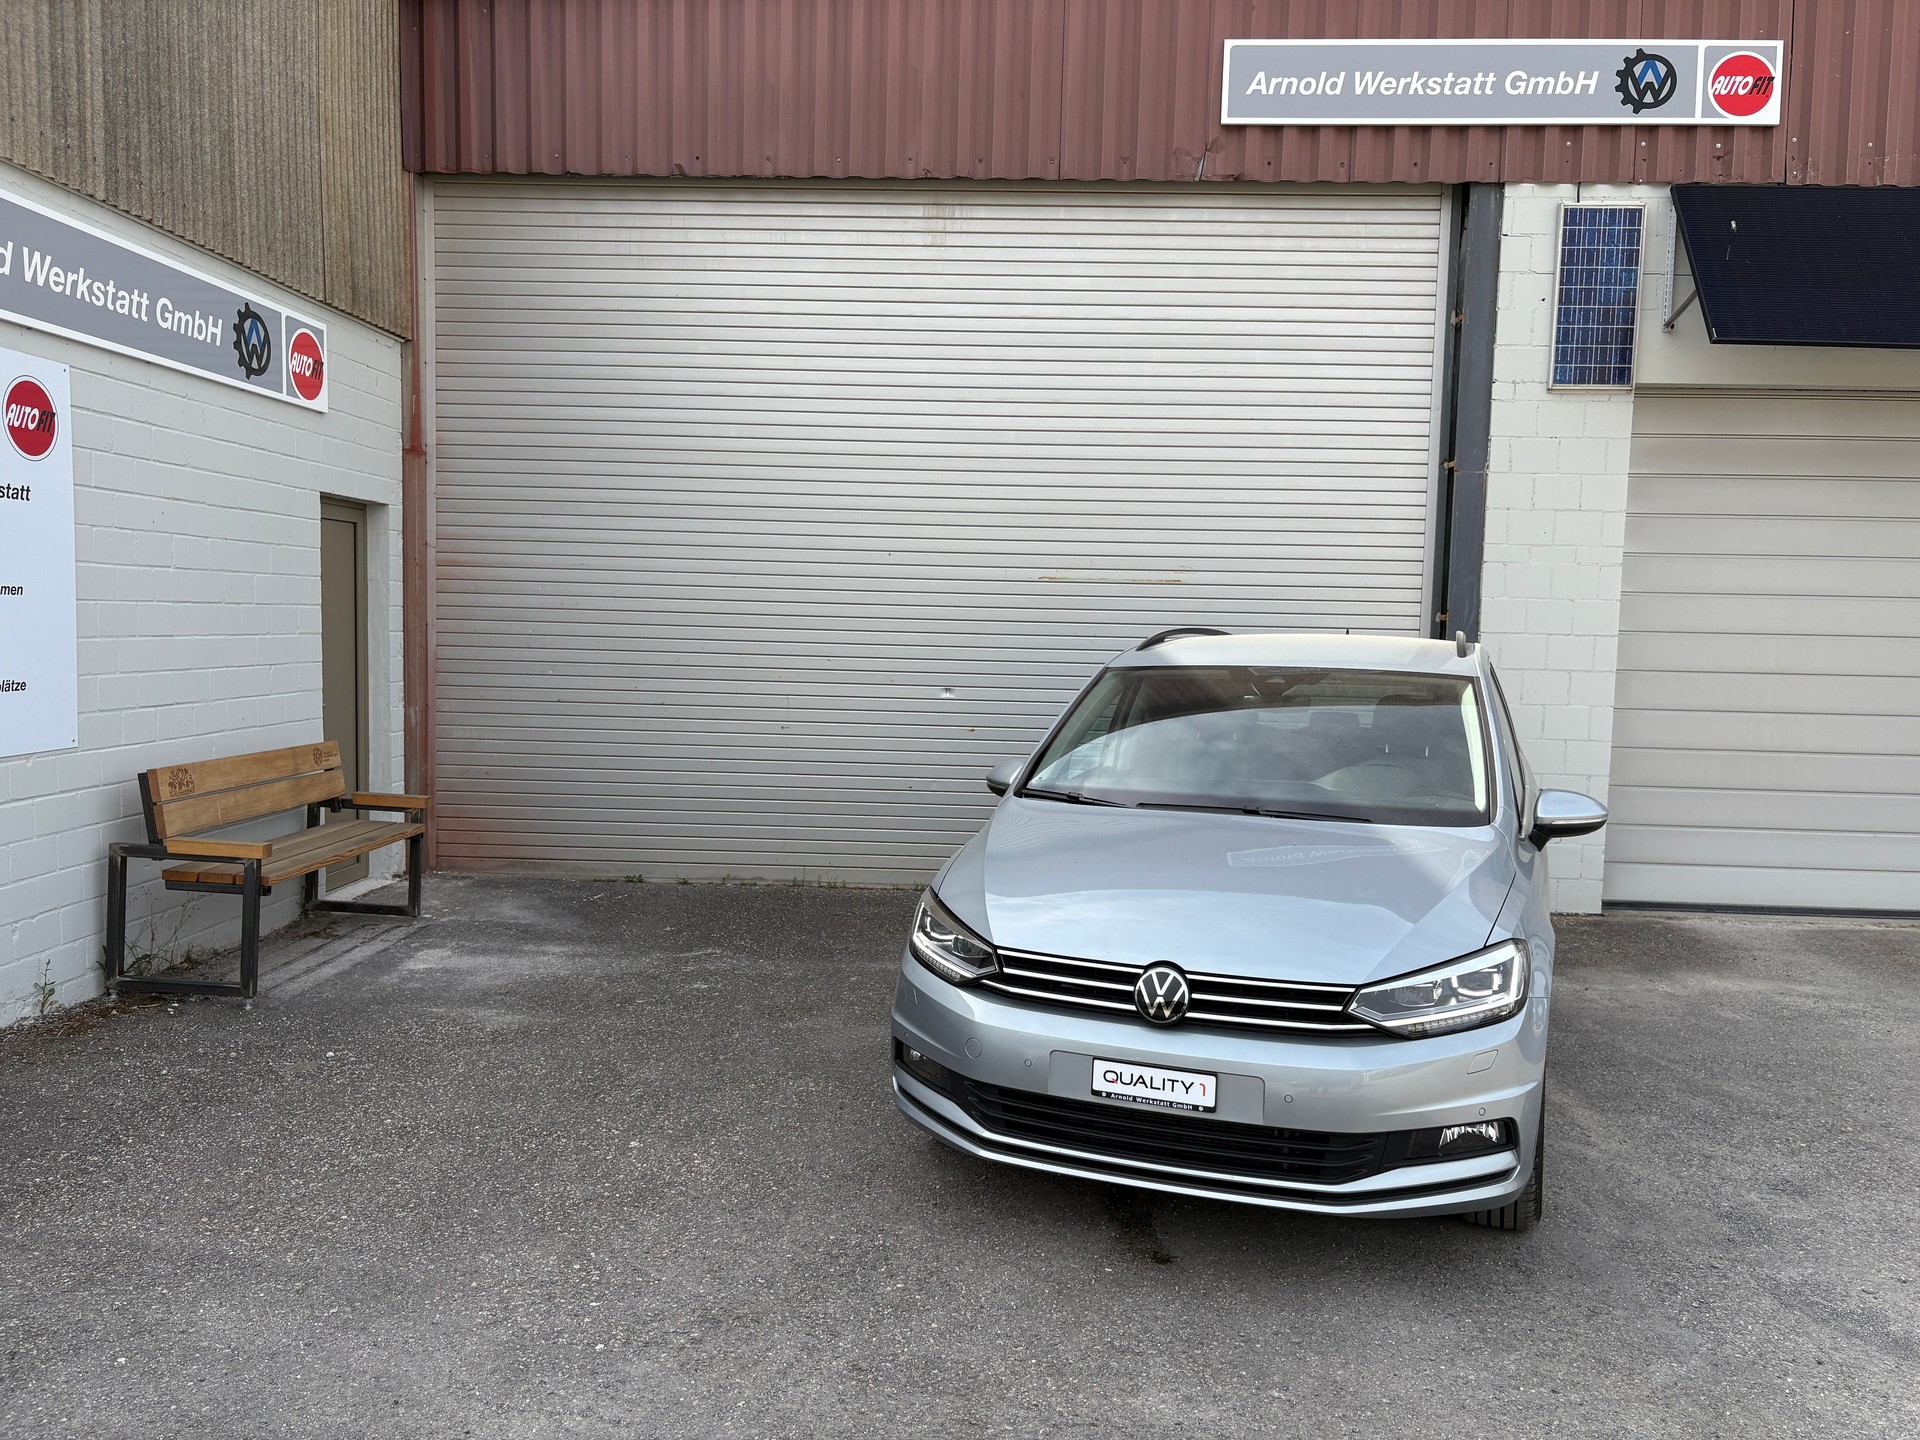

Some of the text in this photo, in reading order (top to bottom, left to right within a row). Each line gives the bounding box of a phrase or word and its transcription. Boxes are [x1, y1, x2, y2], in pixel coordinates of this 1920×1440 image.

[1245, 69, 1600, 96] Arnold Werkstatt GmbH
[22, 245, 150, 322] Werkstatt
[155, 297, 223, 347] GmbH
[0, 679, 27, 693] lätze
[1103, 1069, 1195, 1095] QUALITY
[1110, 1093, 1193, 1111] Arnold Werkstatt GmbH
